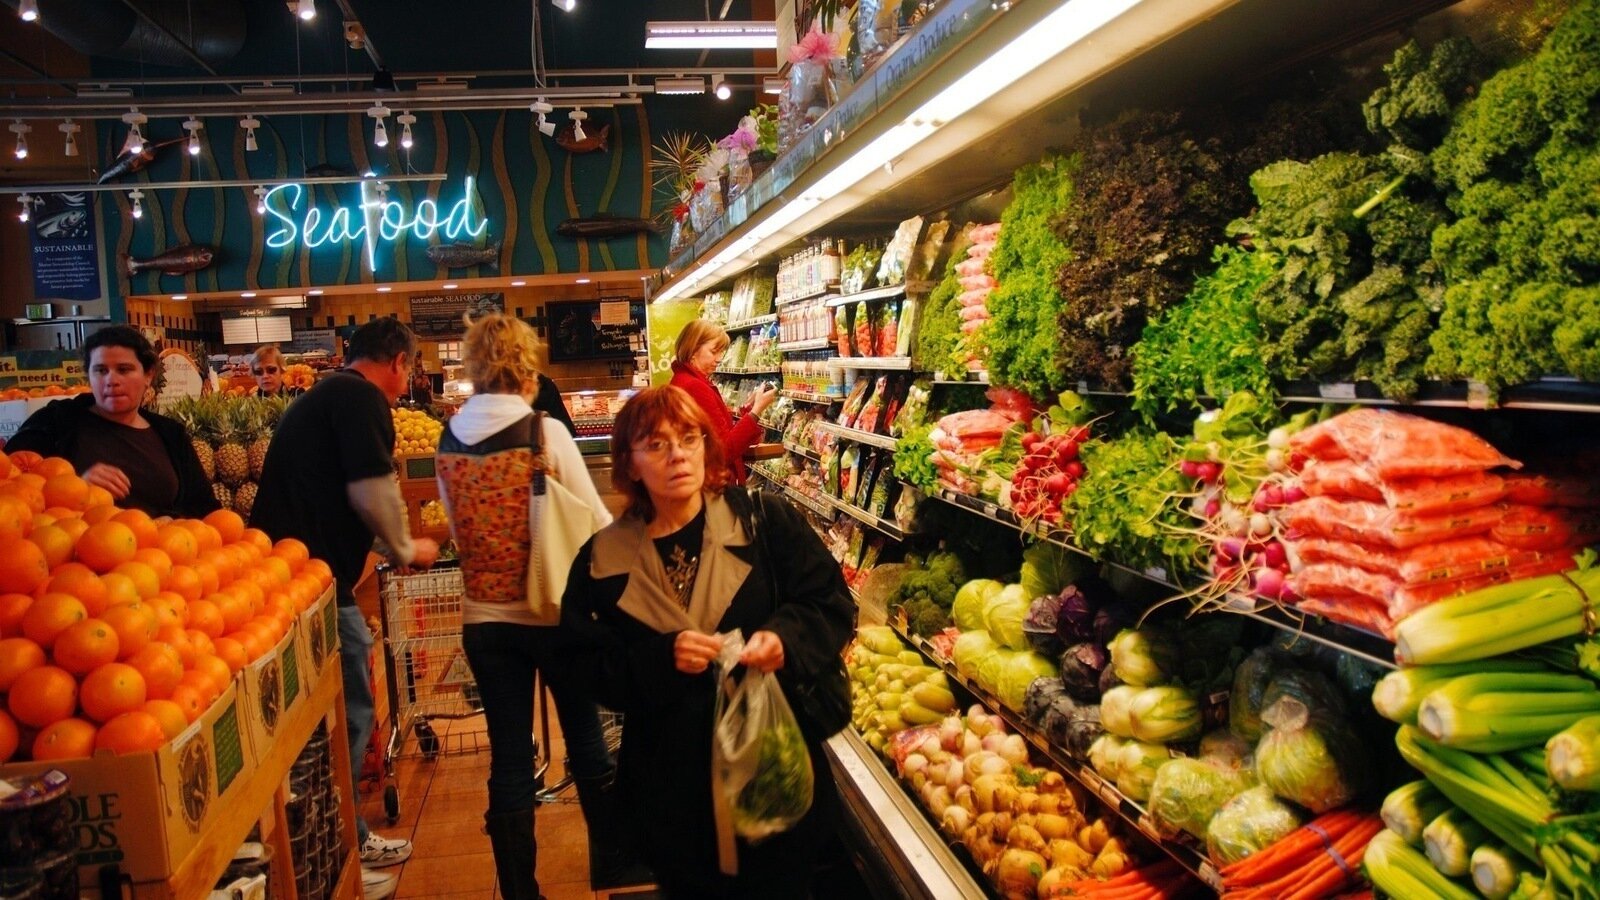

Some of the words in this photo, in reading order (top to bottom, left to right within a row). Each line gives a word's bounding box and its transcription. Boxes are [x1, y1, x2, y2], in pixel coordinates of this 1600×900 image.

[919, 14, 957, 63] Produce
[264, 173, 488, 271] Seafood
[34, 245, 94, 253] SUSTAINABLE
[445, 294, 481, 302] SEAFOOD
[66, 365, 83, 373] ea
[20, 374, 48, 382] need
[51, 374, 64, 382] it.
[66, 793, 121, 822] OLE
